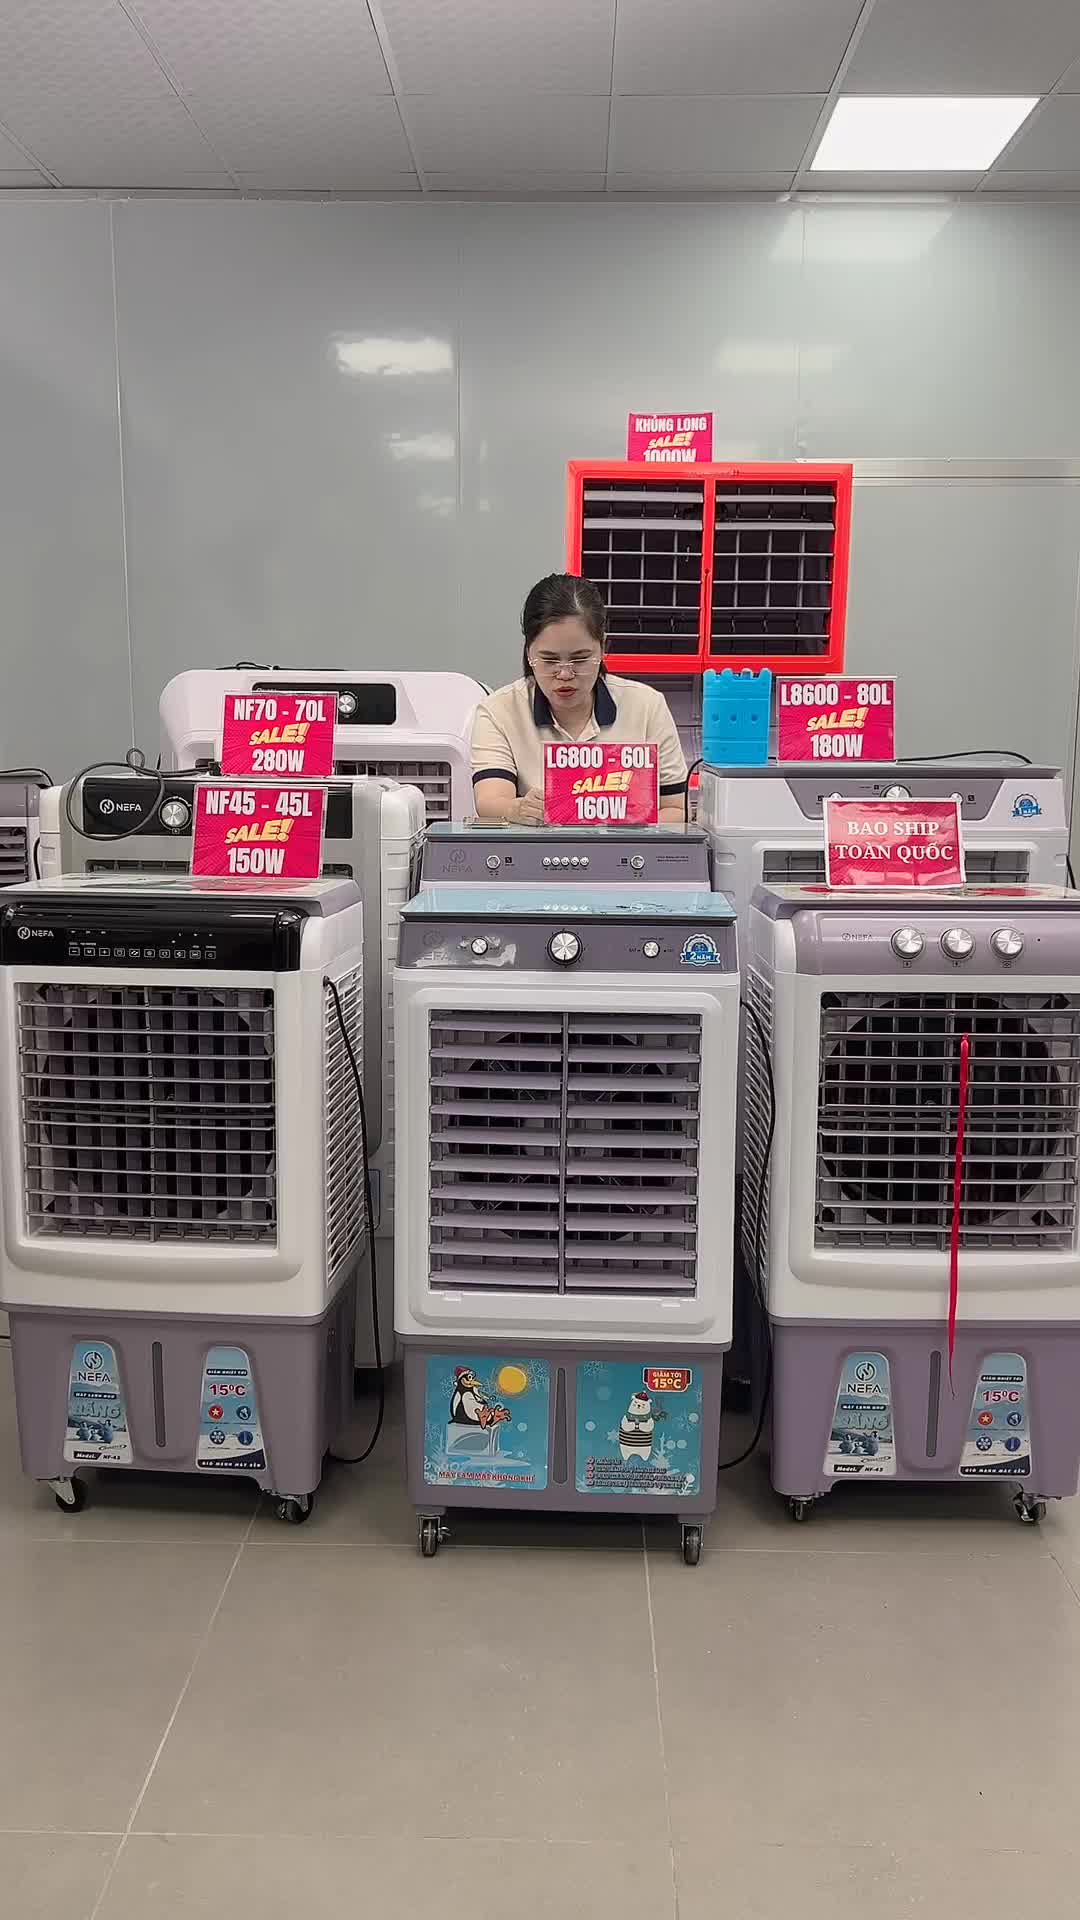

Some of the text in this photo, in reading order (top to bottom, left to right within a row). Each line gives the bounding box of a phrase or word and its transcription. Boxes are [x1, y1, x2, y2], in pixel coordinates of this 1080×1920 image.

[677, 417, 707, 431] LONG
[648, 432, 694, 449] SALE!
[781, 683, 838, 706] L8600
[857, 683, 891, 705] 80L
[234, 699, 277, 720] NF70
[295, 699, 326, 721] 70L
[806, 707, 869, 732] SALE!
[249, 722, 310, 745] SALE!
[547, 746, 603, 768] L6800
[621, 746, 654, 768] 60L
[810, 734, 863, 758] 180W
[252, 749, 305, 772] 280W
[571, 770, 634, 794] SALE!
[116, 803, 142, 812] NEFA
[206, 790, 256, 815] NF45
[275, 792, 313, 816] 45L
[575, 796, 627, 819] 160W
[224, 817, 294, 844] SALE!
[847, 821, 939, 836] BAO SHIP
[227, 847, 285, 874] 150W
[834, 841, 953, 864] TOÀN QUỐC
[442, 864, 472, 873] NEFA
[690, 952, 696, 960] 2
[78, 1371, 111, 1383] NEFA
[847, 1383, 882, 1394] NEFA
